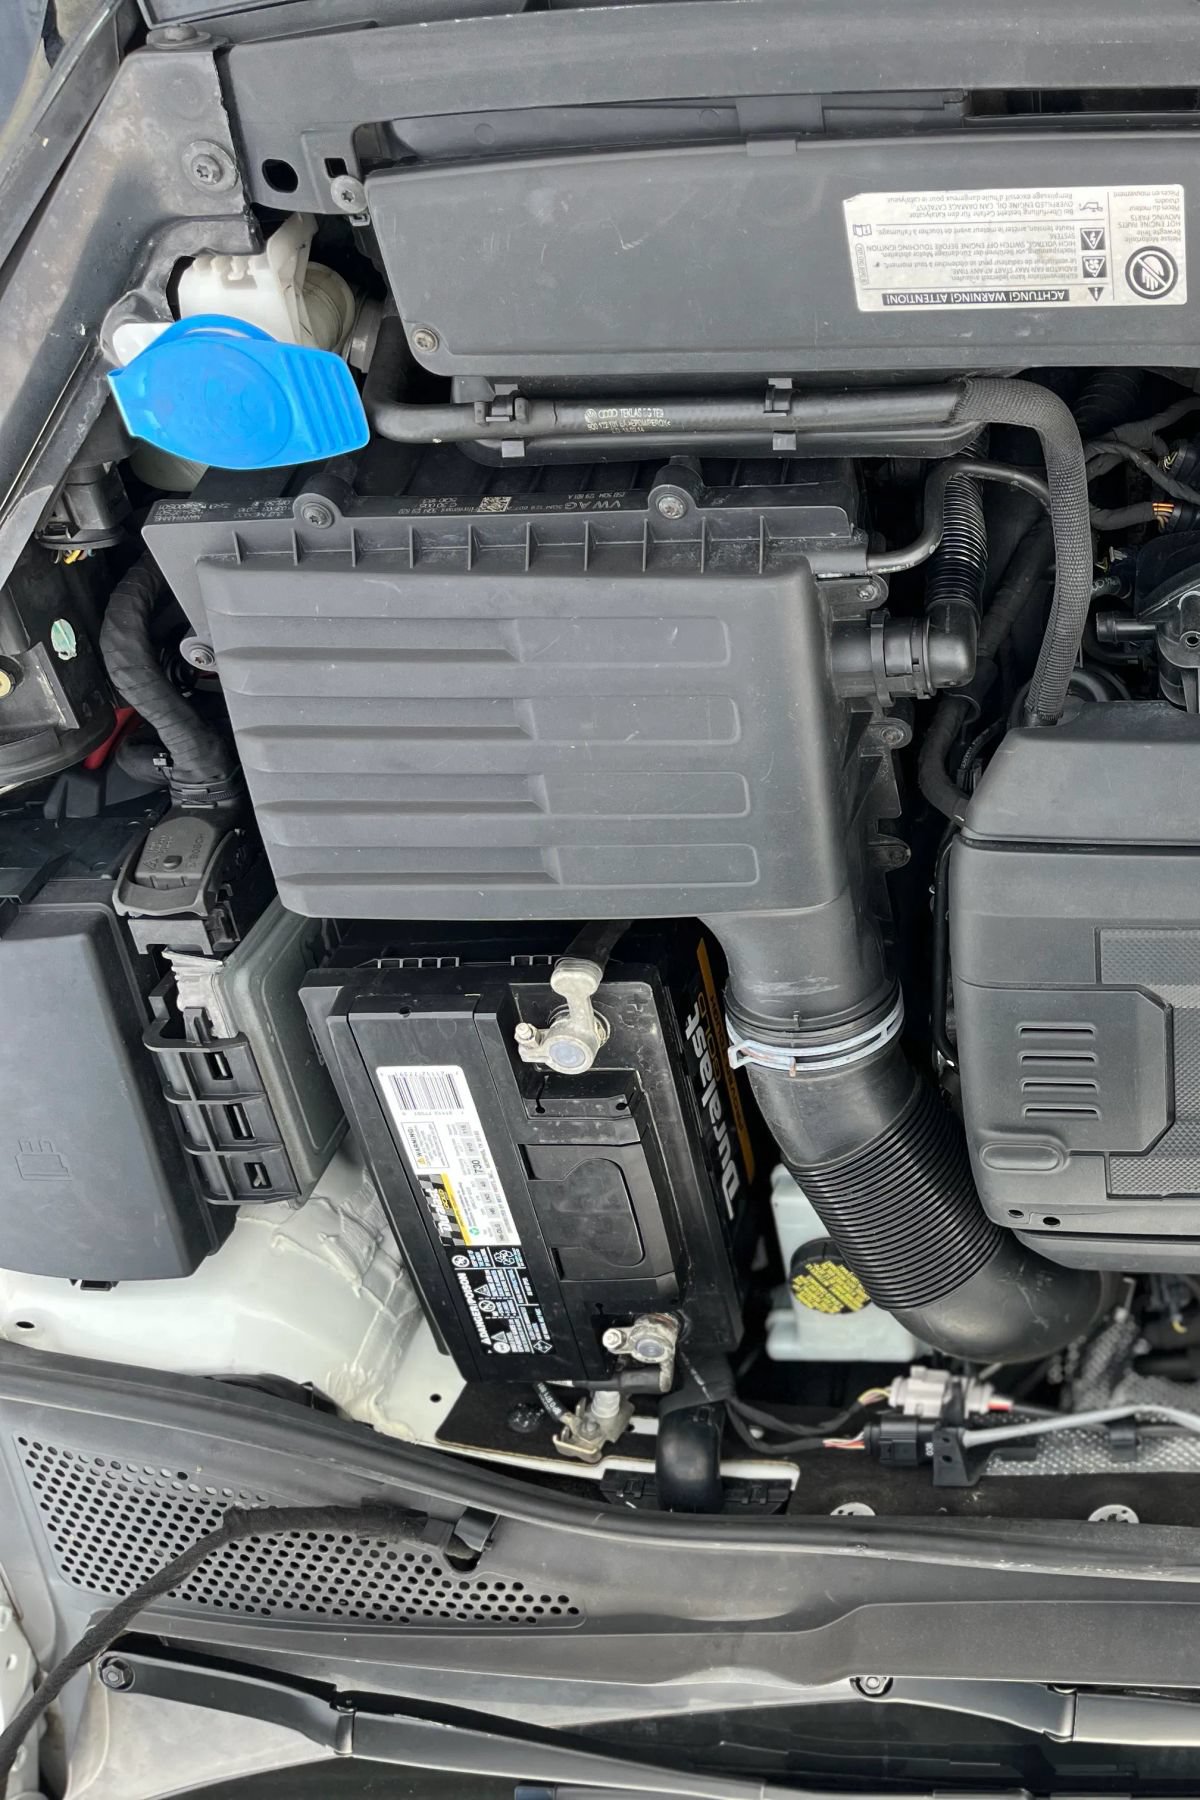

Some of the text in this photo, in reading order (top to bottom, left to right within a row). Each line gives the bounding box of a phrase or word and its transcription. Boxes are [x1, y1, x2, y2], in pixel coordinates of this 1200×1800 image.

[886, 289, 1064, 304] ACHTUNG! WARNING! ATTENTION!
[619, 408, 642, 418] TEKLAS
[564, 500, 620, 510] VW AG
[698, 991, 722, 1083] GOLD
[711, 994, 728, 1052] TOUGH
[685, 1000, 740, 1220] Duralast
[470, 1159, 484, 1173] 730
[424, 1187, 453, 1232] Duralast
[456, 1272, 489, 1337] DANGER/POISON
